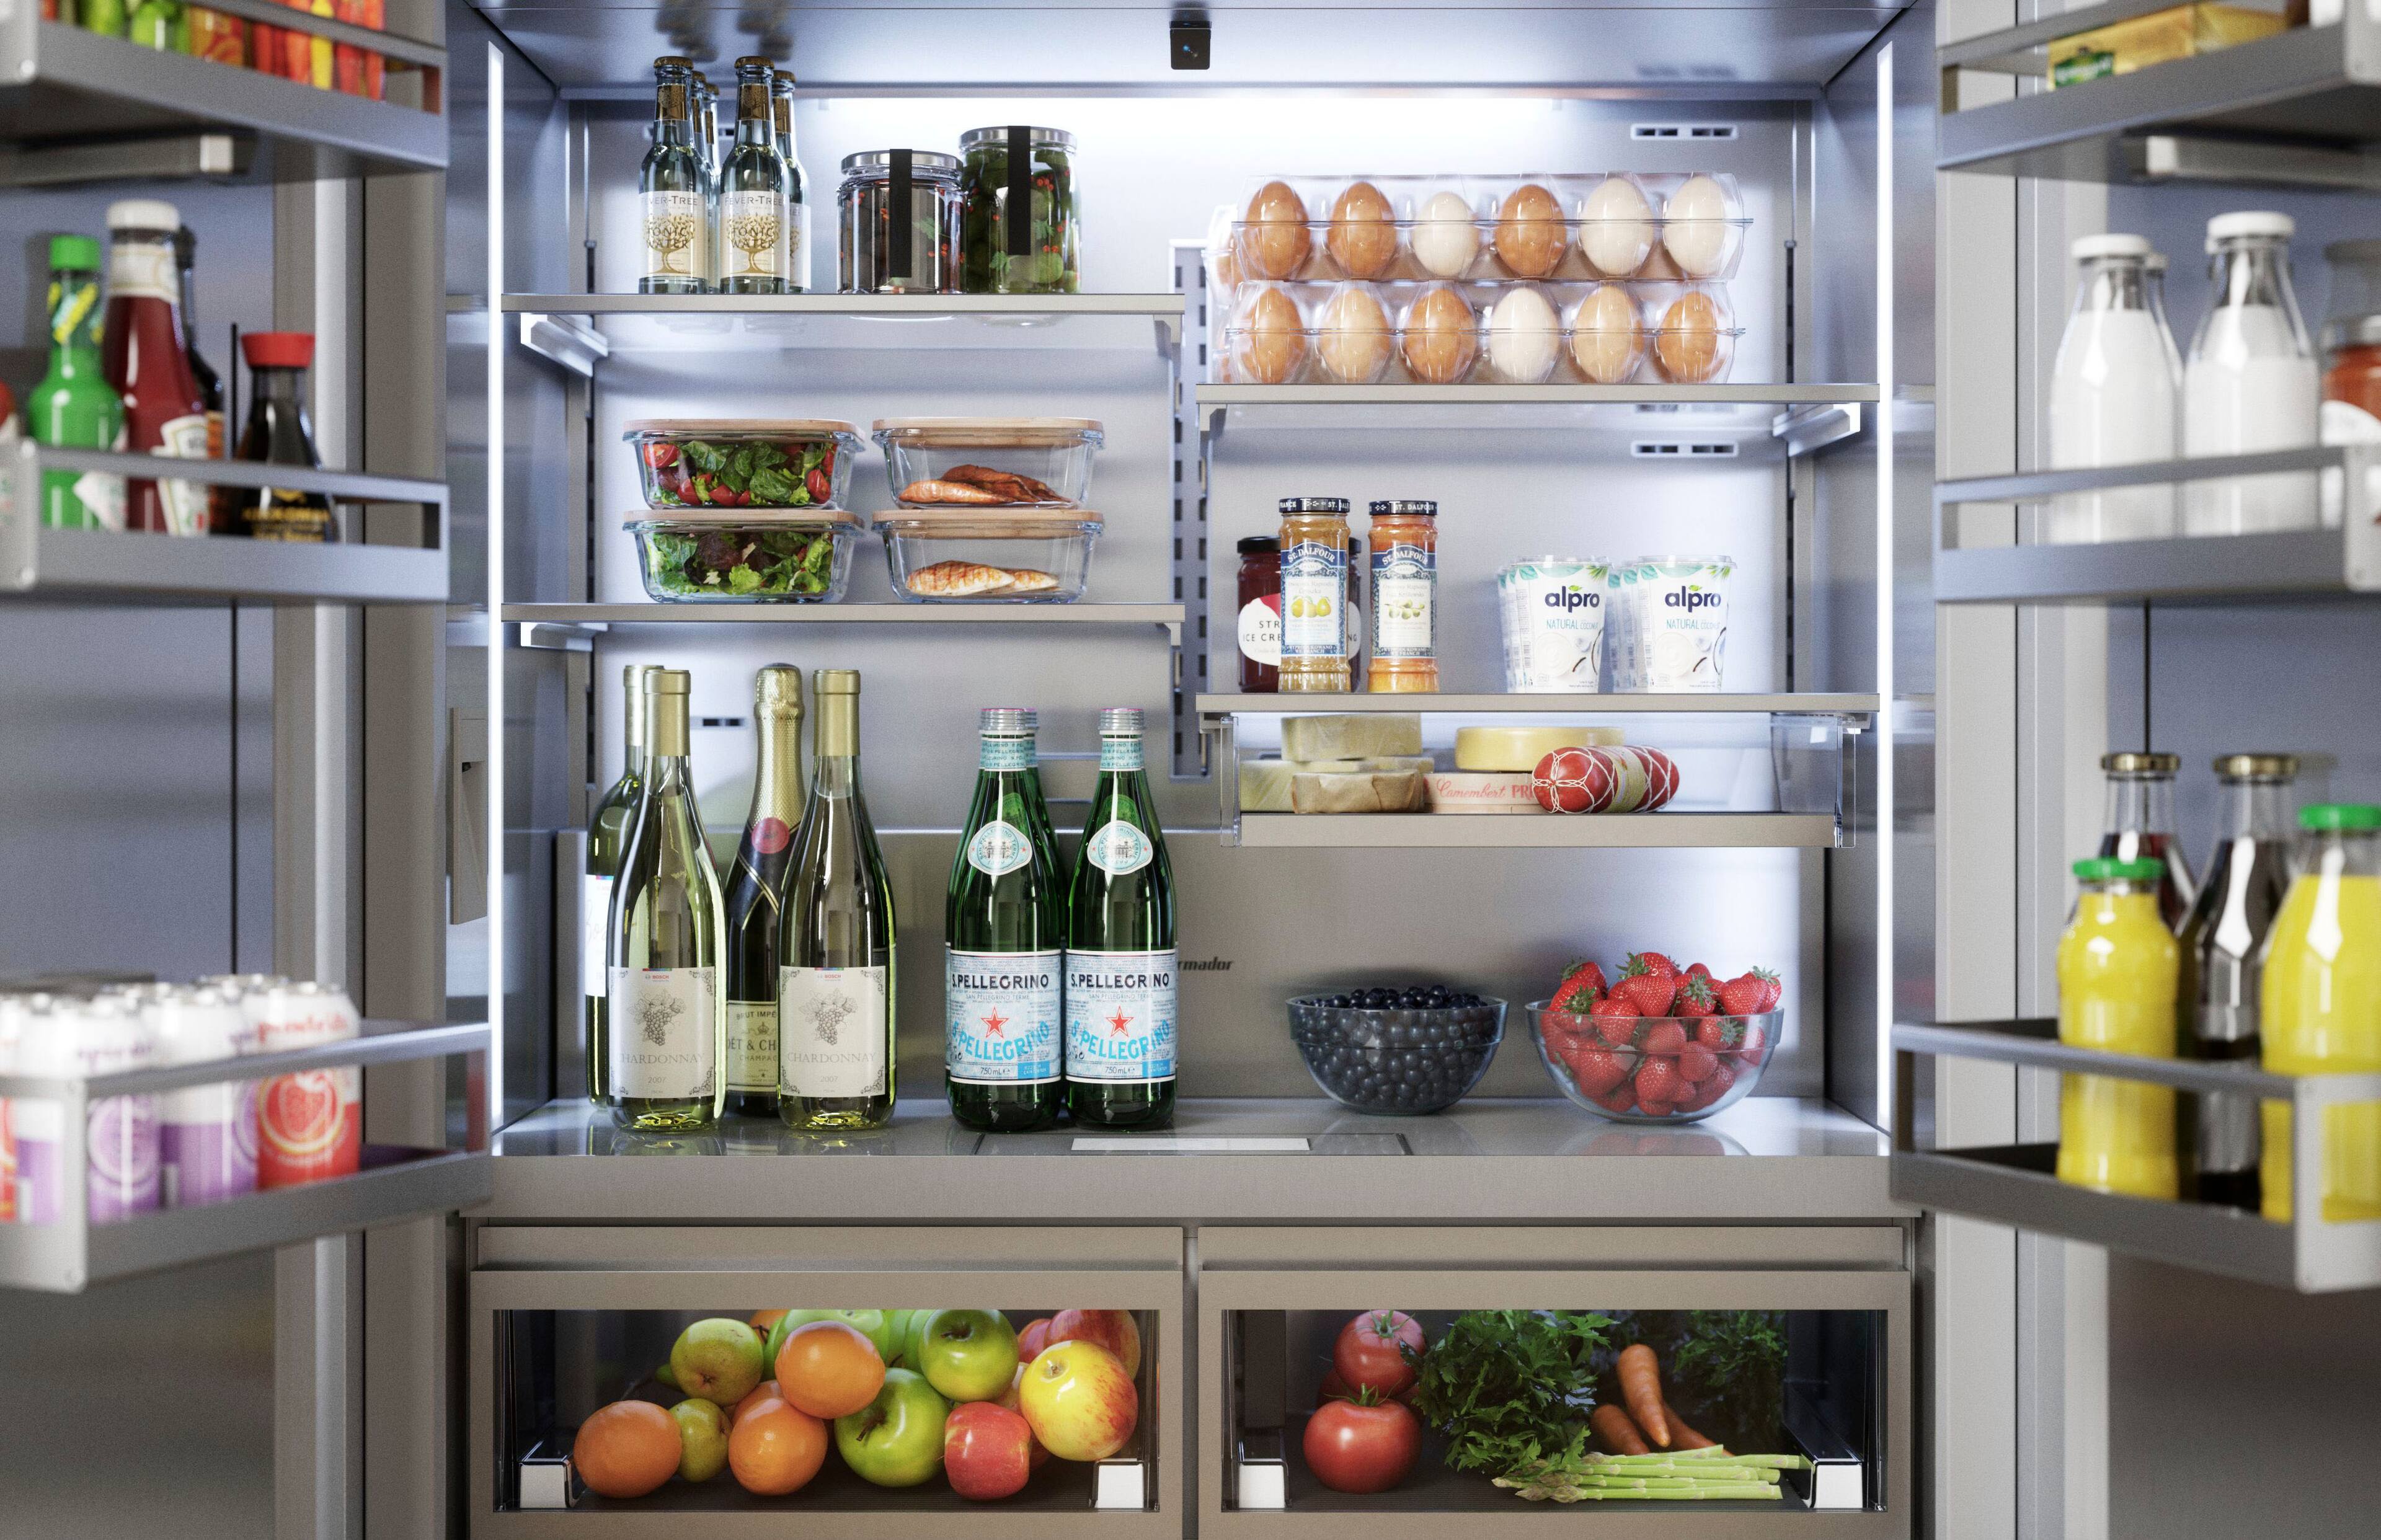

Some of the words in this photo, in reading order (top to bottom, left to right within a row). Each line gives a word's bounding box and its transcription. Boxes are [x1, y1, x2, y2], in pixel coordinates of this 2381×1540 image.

[725, 195, 783, 206] FEVER-TREE
[647, 227, 687, 237] TONIC
[732, 227, 774, 237] TONIC
[646, 239, 689, 249] WATER
[732, 239, 774, 249] WATER
[1287, 553, 1298, 564] ST.
[1298, 547, 1336, 563] DALFOUR
[1381, 555, 1393, 565] ST.
[1394, 551, 1428, 566] DALFOUR
[1545, 585, 1600, 613] alpro
[1664, 585, 1721, 613] alpro
[1546, 619, 1579, 629] NATURAL
[1666, 619, 1700, 629] NATURAL
[1243, 634, 1255, 642] ICE
[1261, 633, 1281, 642] CRE
[1437, 778, 1506, 799] Camembert
[1178, 956, 1233, 971] rmador
[952, 973, 1049, 989] S.PELLEGRINO
[737, 1011, 755, 1020] BRUT
[757, 1010, 777, 1018] IMPÉ
[747, 1039, 755, 1051] &
[952, 1020, 1050, 1061] S.PELLEGRINO
[1071, 1019, 1171, 1060] S.PELLEGRINO
[619, 1053, 706, 1064] HARDONNAY
[787, 1052, 877, 1064] CHARDONNAY
[980, 1066, 991, 1075] 750
[993, 1067, 1002, 1076] mL
[1104, 1066, 1117, 1074] 750
